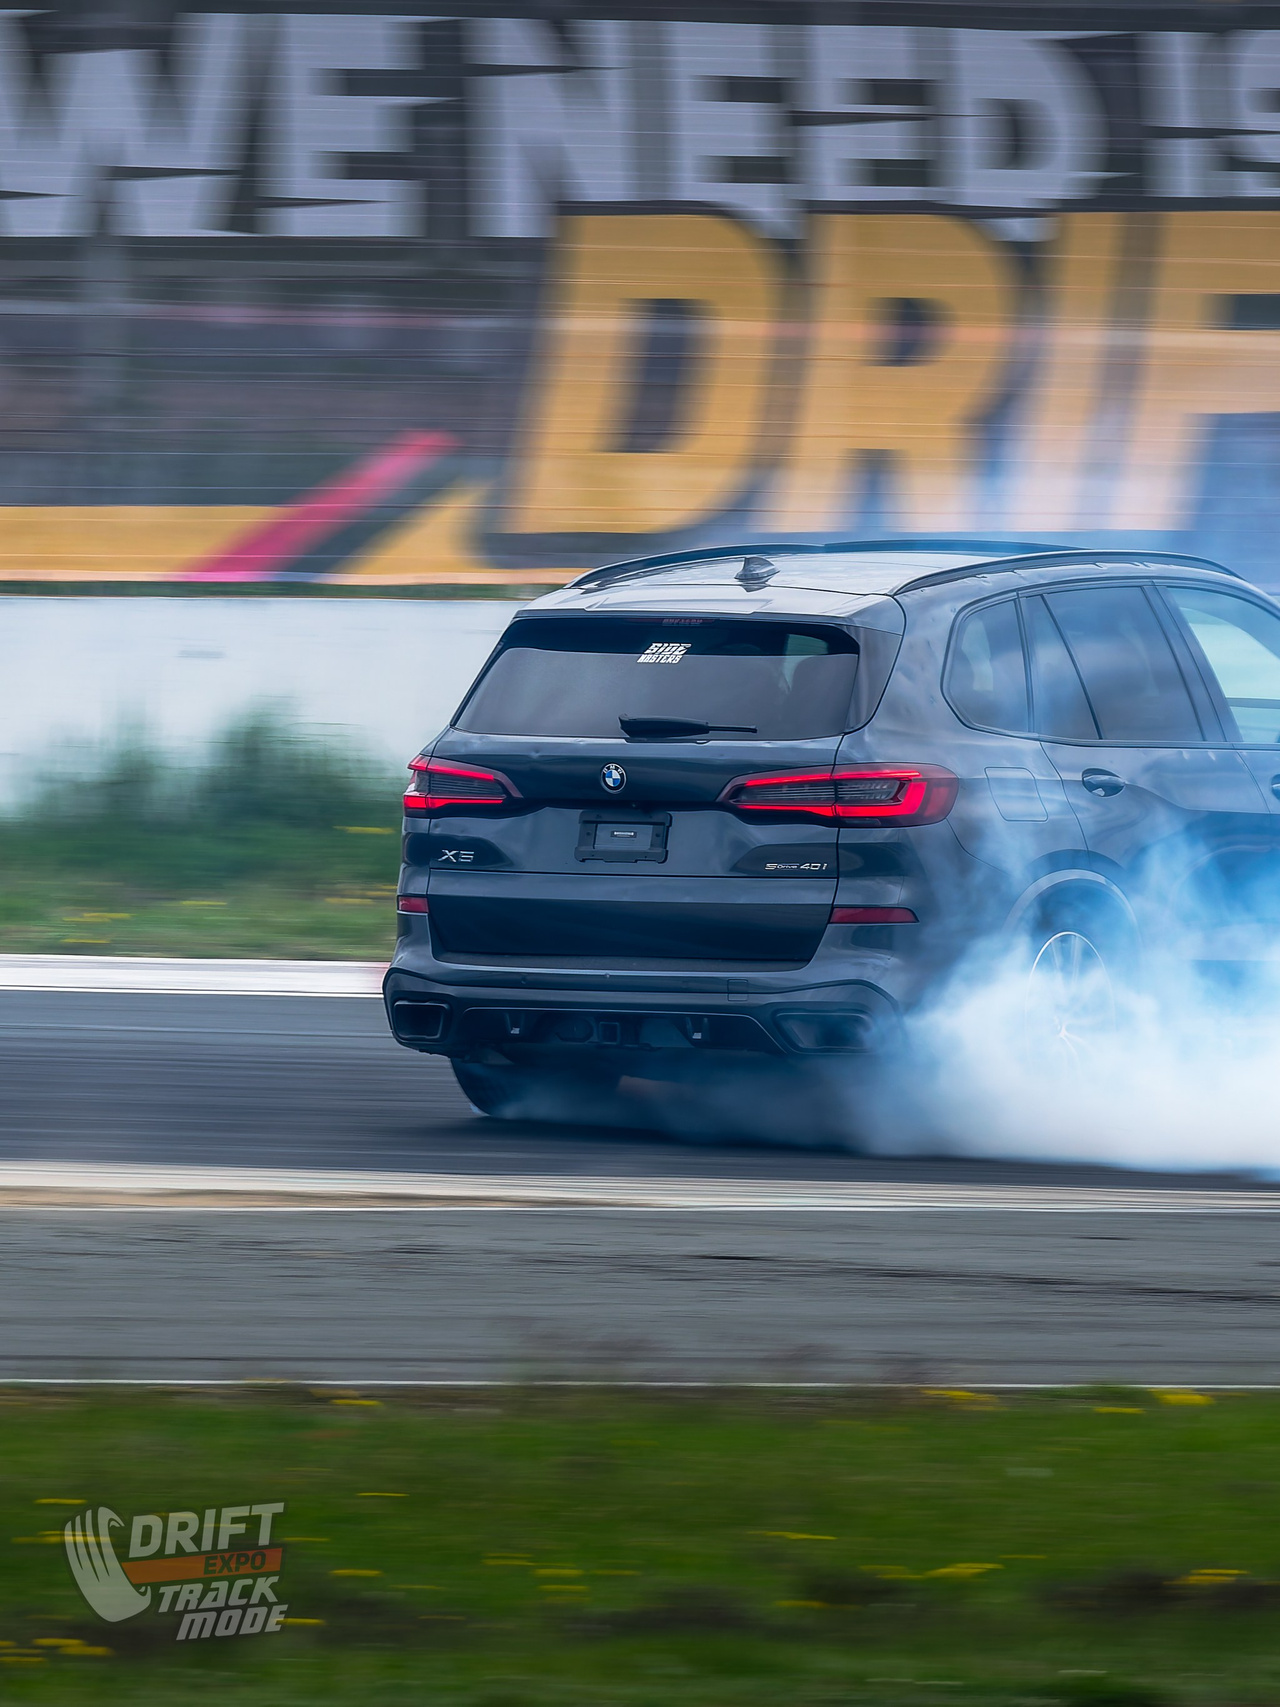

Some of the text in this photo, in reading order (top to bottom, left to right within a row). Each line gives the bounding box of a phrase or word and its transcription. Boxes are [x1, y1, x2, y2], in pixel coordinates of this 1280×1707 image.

[0, 10, 428, 238] WE
[464, 16, 1108, 241] NEED
[637, 654, 683, 664] MASTERS
[438, 849, 475, 863] X5
